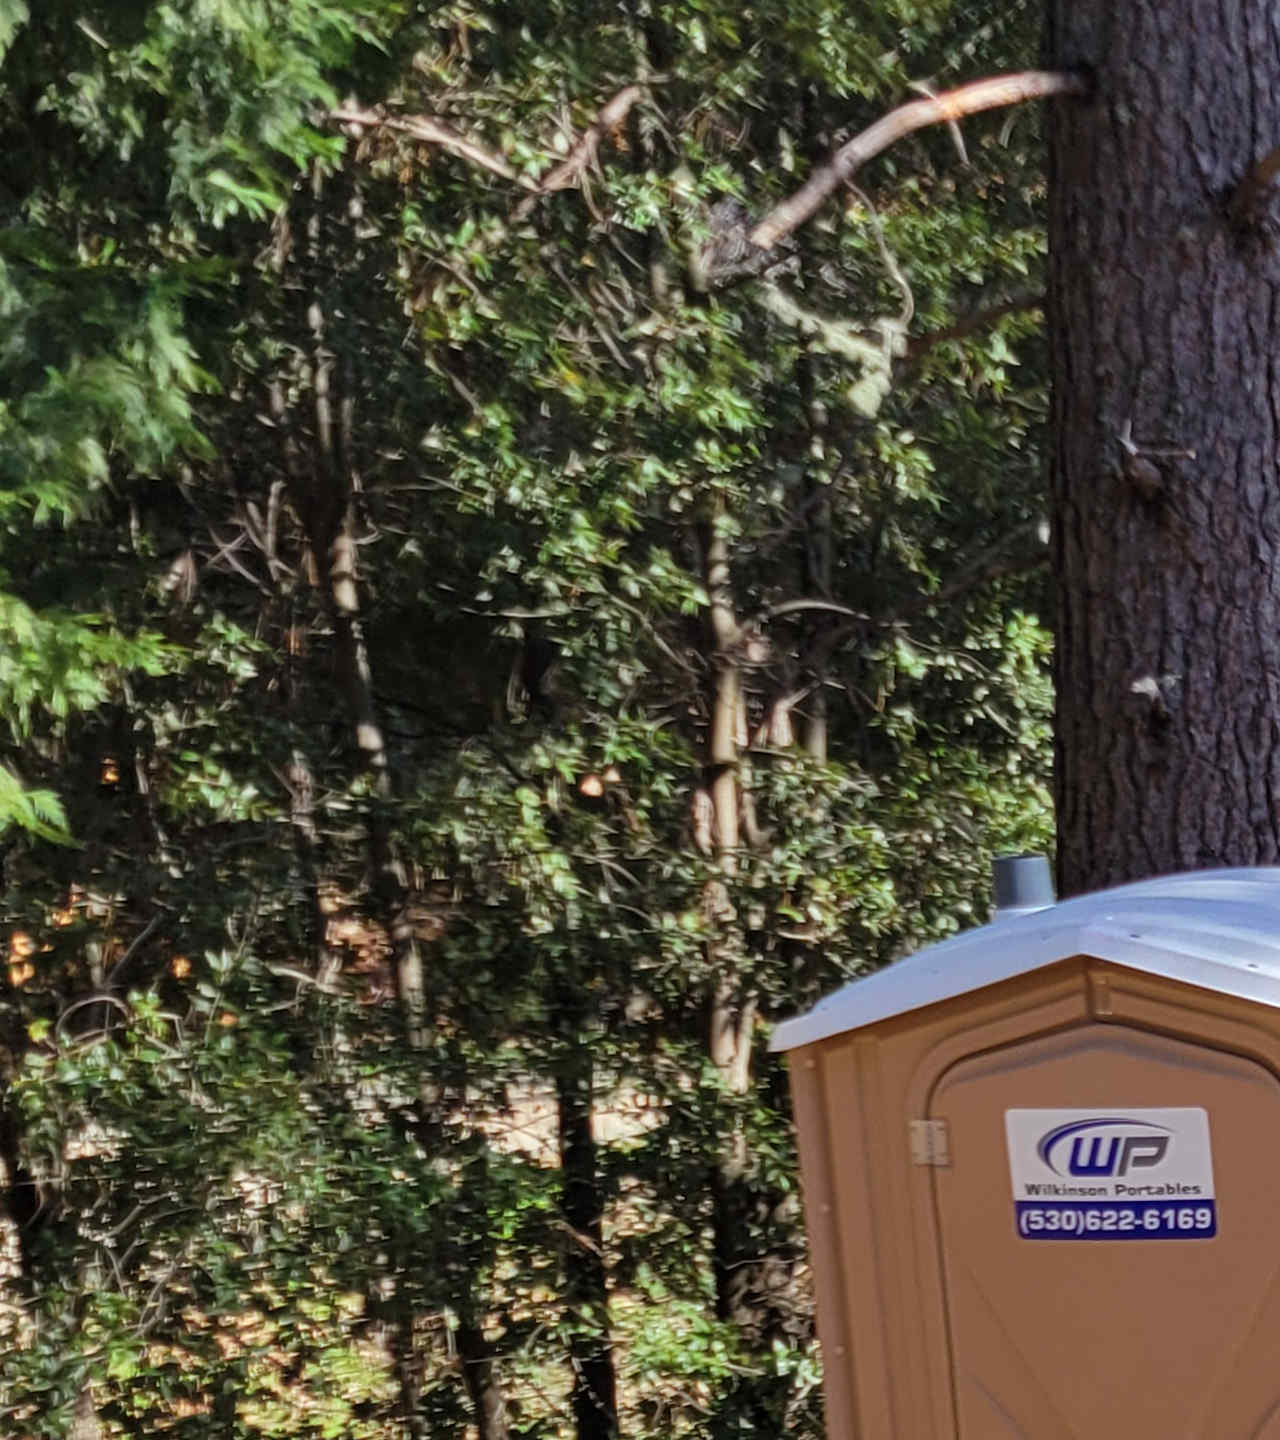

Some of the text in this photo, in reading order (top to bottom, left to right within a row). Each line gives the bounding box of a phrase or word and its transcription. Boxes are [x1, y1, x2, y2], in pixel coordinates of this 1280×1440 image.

[1069, 1136, 1170, 1177] WP
[1024, 1183, 1202, 1197] Wilkinson Portables
[1020, 1208, 1212, 1235] (530)622-6169
